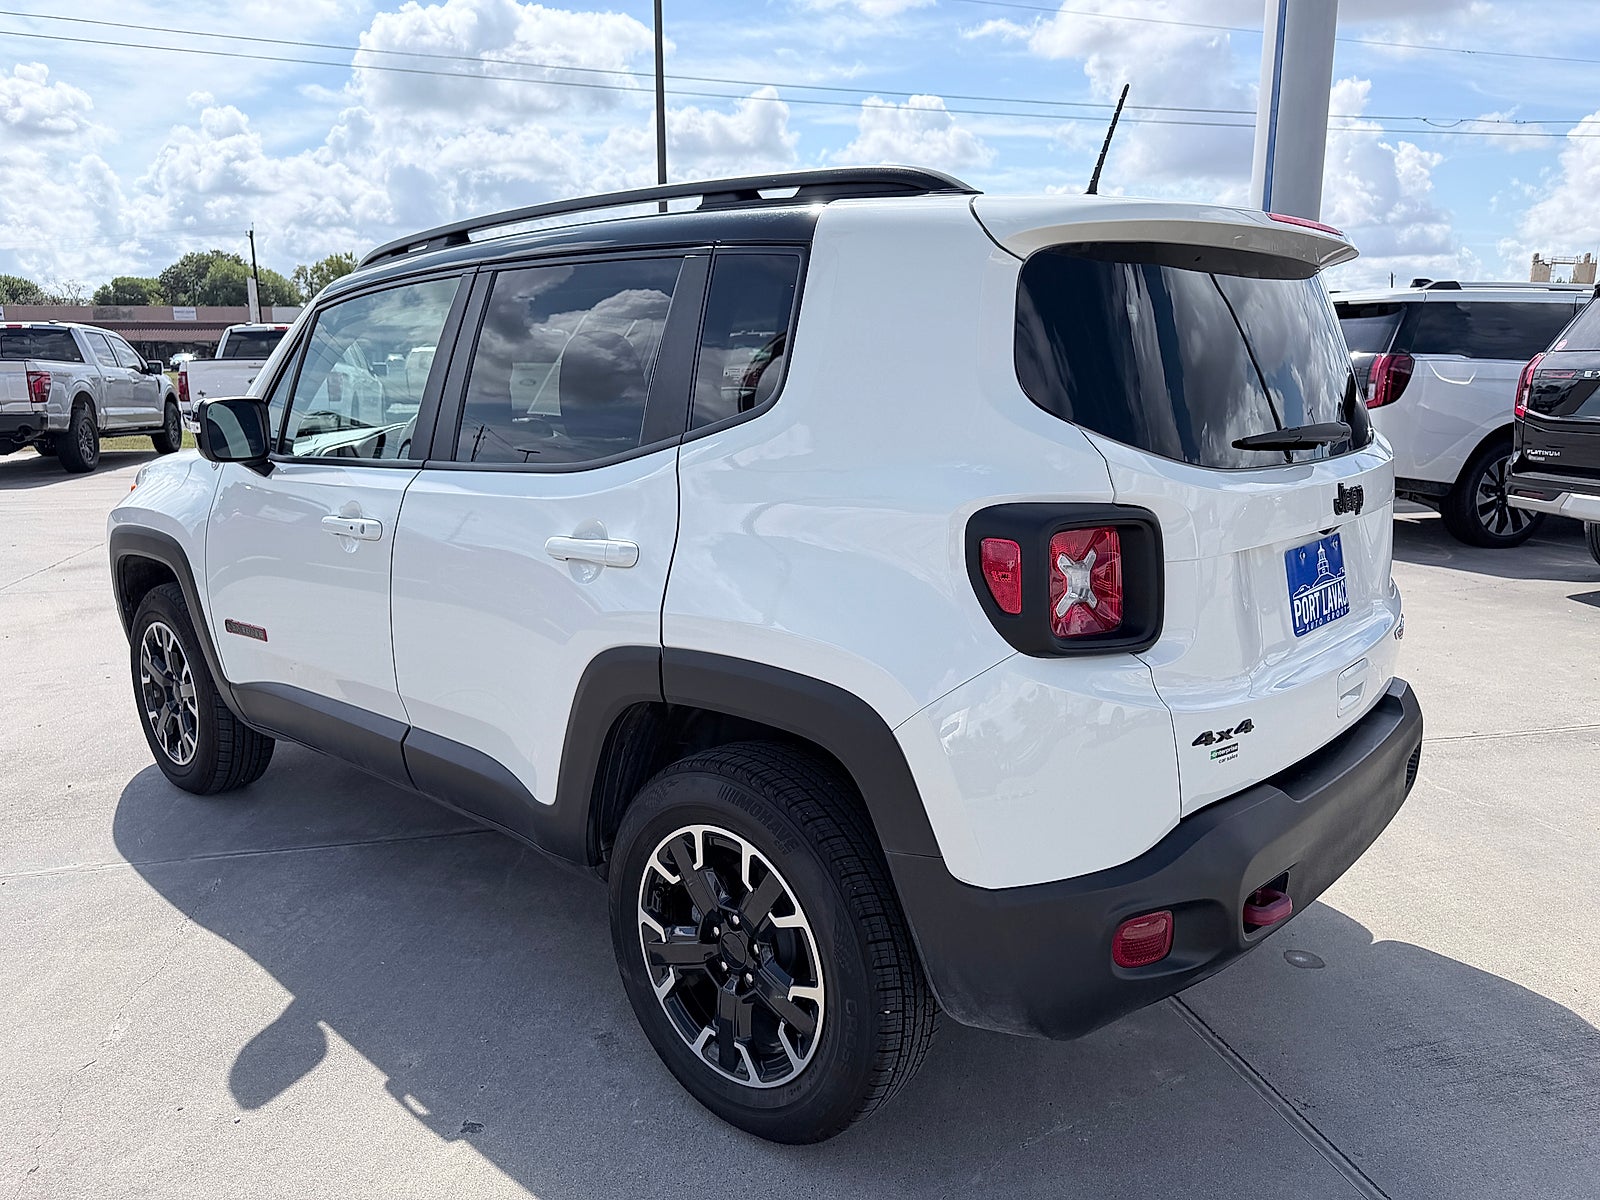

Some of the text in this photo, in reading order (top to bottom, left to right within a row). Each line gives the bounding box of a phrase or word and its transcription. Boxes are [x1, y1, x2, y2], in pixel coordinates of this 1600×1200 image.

[1333, 482, 1364, 515] Jeep
[1293, 579, 1348, 628] PORT LAVAC
[1191, 718, 1255, 747] 4x4
[1210, 744, 1239, 759] enterprise
